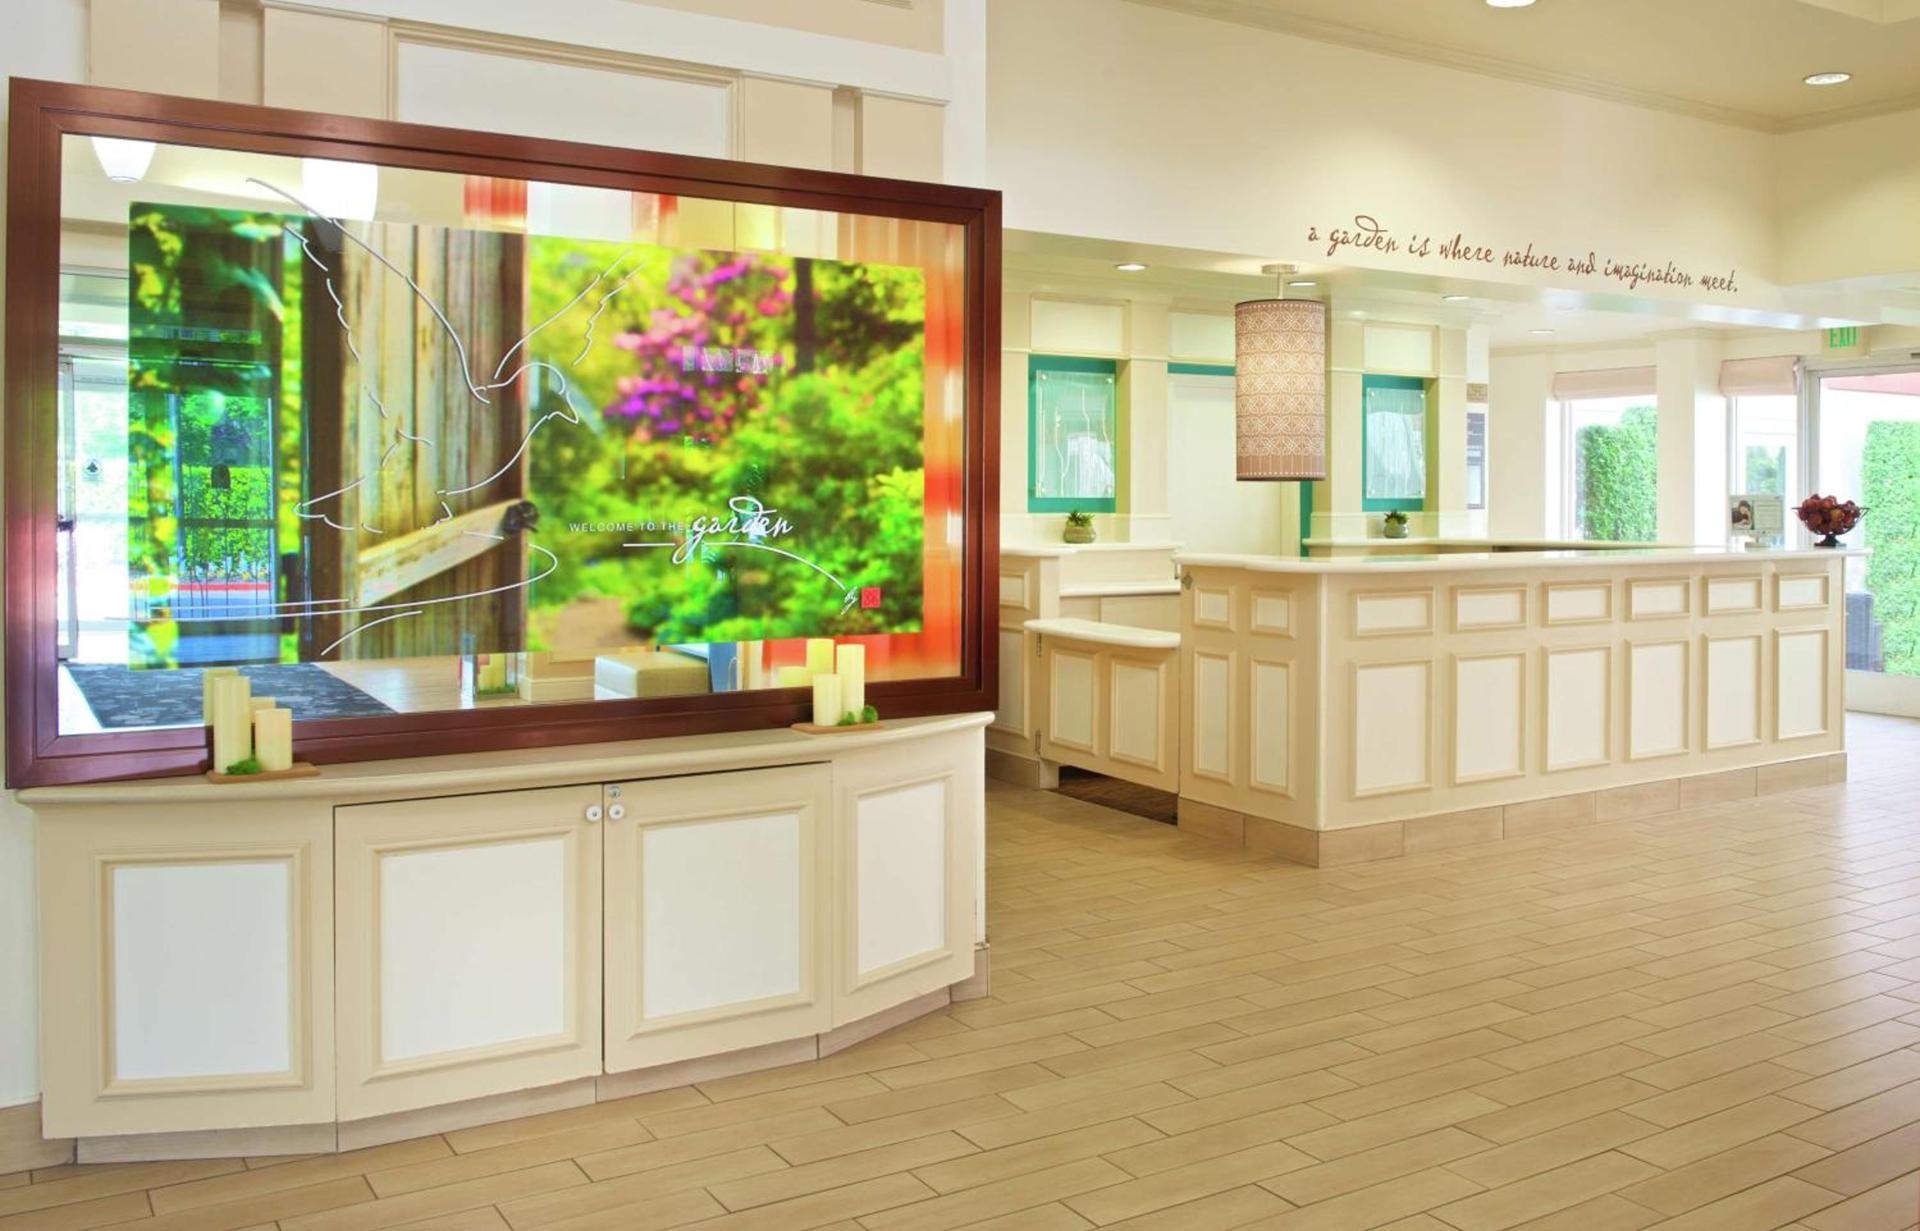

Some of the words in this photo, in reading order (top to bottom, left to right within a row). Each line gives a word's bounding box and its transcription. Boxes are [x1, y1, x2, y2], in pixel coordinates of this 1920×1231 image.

[1308, 227, 1319, 241] a
[1327, 215, 1399, 257] garden
[1408, 235, 1431, 258] is
[1439, 233, 1495, 263] where
[1503, 243, 1561, 270] nature
[1568, 252, 1597, 275] and
[1604, 259, 1694, 290] imagination
[1699, 270, 1738, 292] meet.
[568, 522, 633, 532] WELCOME
[640, 521, 656, 531] TO
[661, 521, 684, 531] THE
[672, 496, 793, 564] garden
